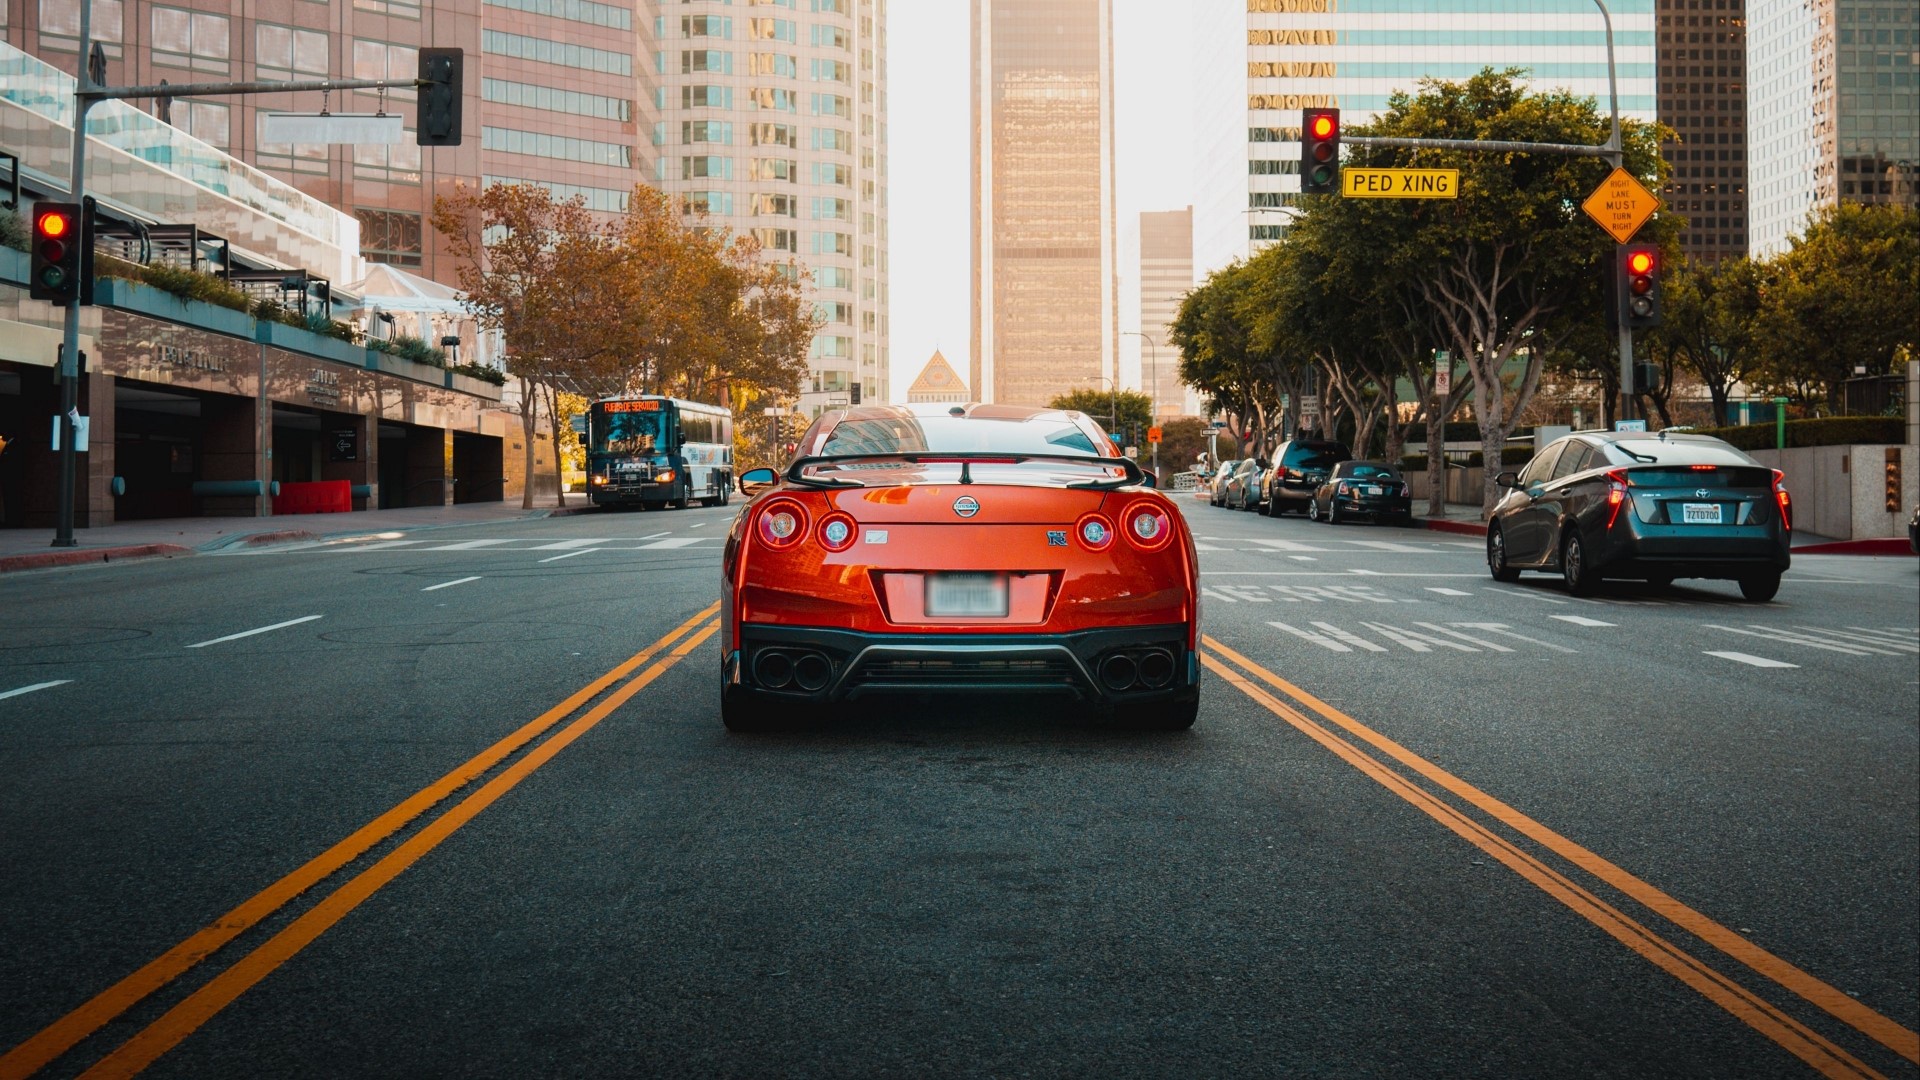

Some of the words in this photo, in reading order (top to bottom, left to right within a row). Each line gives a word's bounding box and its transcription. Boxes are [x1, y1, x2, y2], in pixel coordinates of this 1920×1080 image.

[1353, 175, 1392, 191] PED
[1402, 175, 1448, 192] XING
[1611, 190, 1630, 198] LANE
[1606, 200, 1636, 210] MUST
[1612, 212, 1631, 220] TURN
[604, 401, 623, 412] FUERA
[623, 401, 631, 412] DE
[631, 400, 659, 411] SERVICIO
